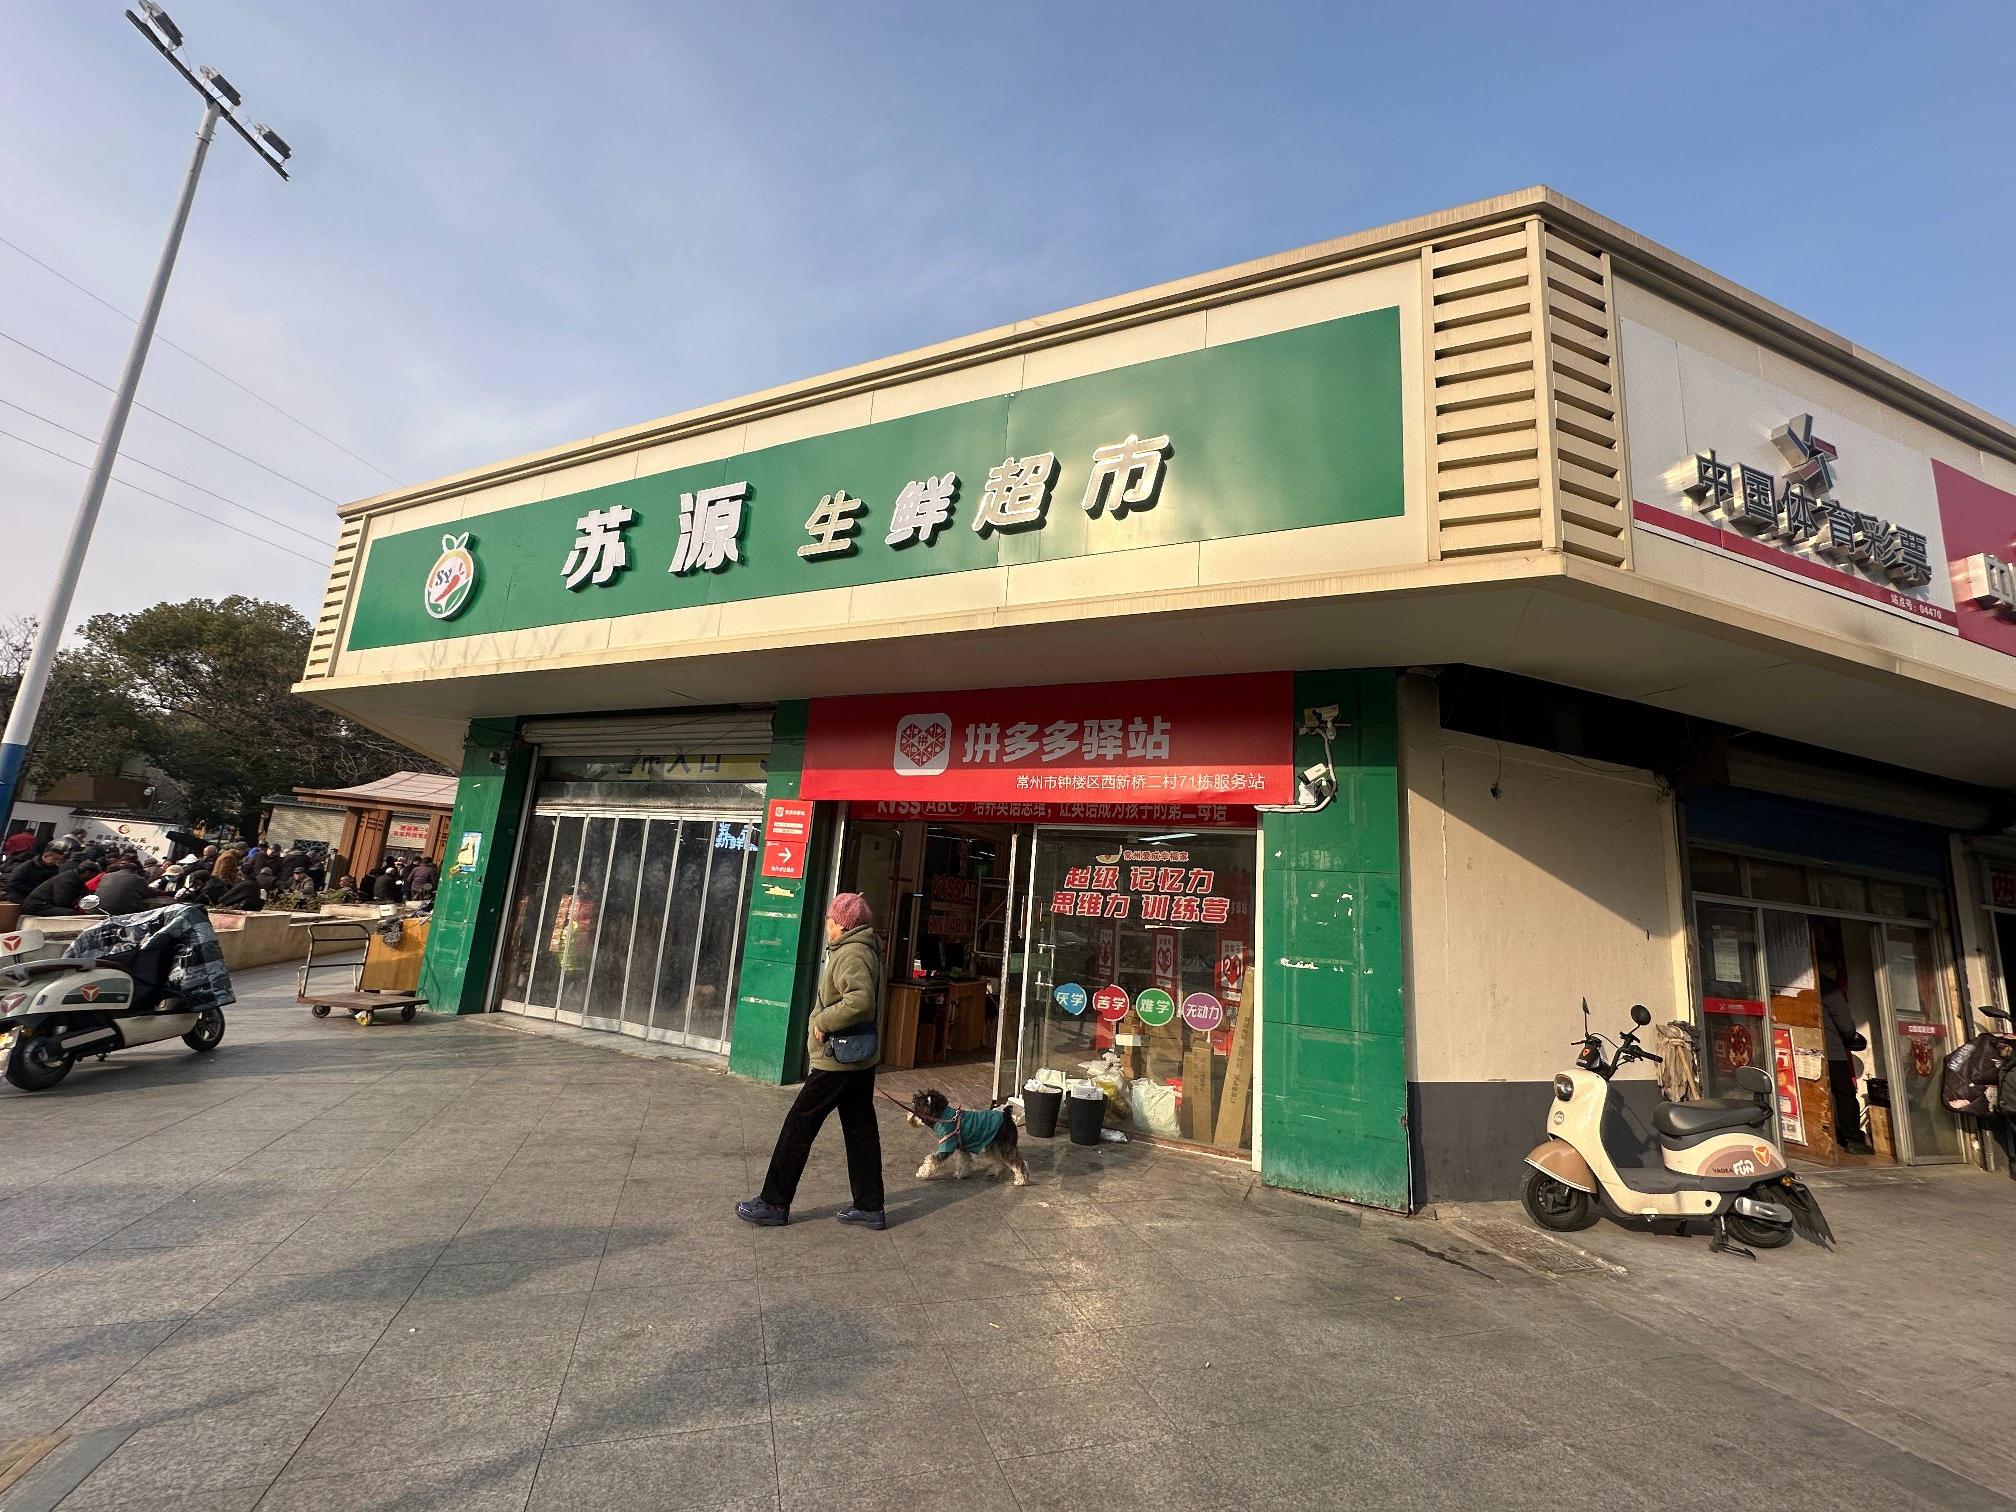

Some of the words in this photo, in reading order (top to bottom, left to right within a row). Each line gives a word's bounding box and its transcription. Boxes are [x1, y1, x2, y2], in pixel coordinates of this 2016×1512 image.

[1696, 448, 1932, 582] 中国体育彩票
[435, 568, 453, 587] SY
[962, 716, 1171, 763] 拼多多驿站
[1016, 772, 1265, 790] 常州市钟楼区西新桥二村71栋服务站
[1064, 866, 1120, 891] 超级
[1129, 867, 1214, 894] 记忆力
[1050, 891, 1131, 918] 思维力
[1141, 894, 1230, 924] 训练营
[1140, 998, 1170, 1014] 难学
[1186, 1004, 1220, 1020] 无动力
